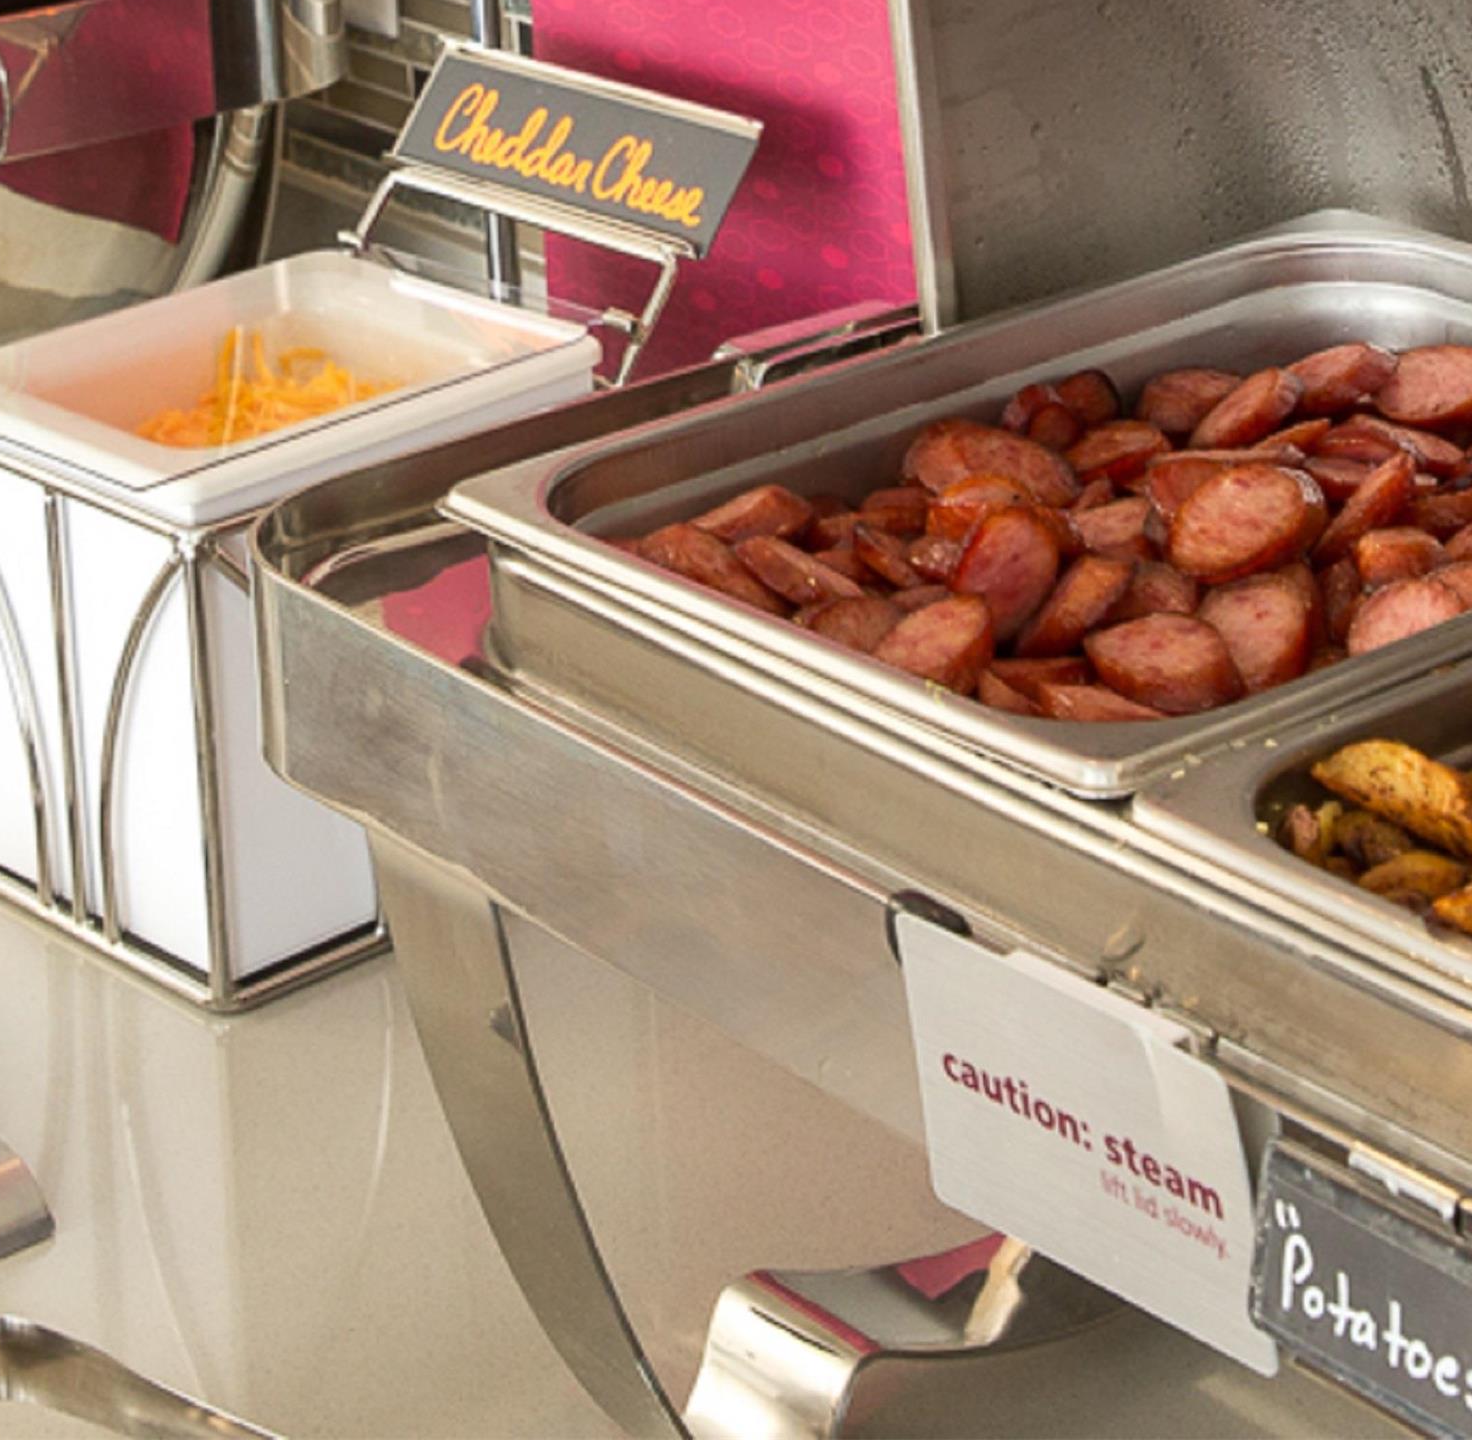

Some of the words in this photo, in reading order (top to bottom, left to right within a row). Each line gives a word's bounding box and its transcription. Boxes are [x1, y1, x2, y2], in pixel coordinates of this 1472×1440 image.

[436, 83, 594, 192] Cheddar
[594, 136, 704, 226] Cheese
[942, 1052, 1093, 1152] caution:
[1103, 1133, 1225, 1221] steam
